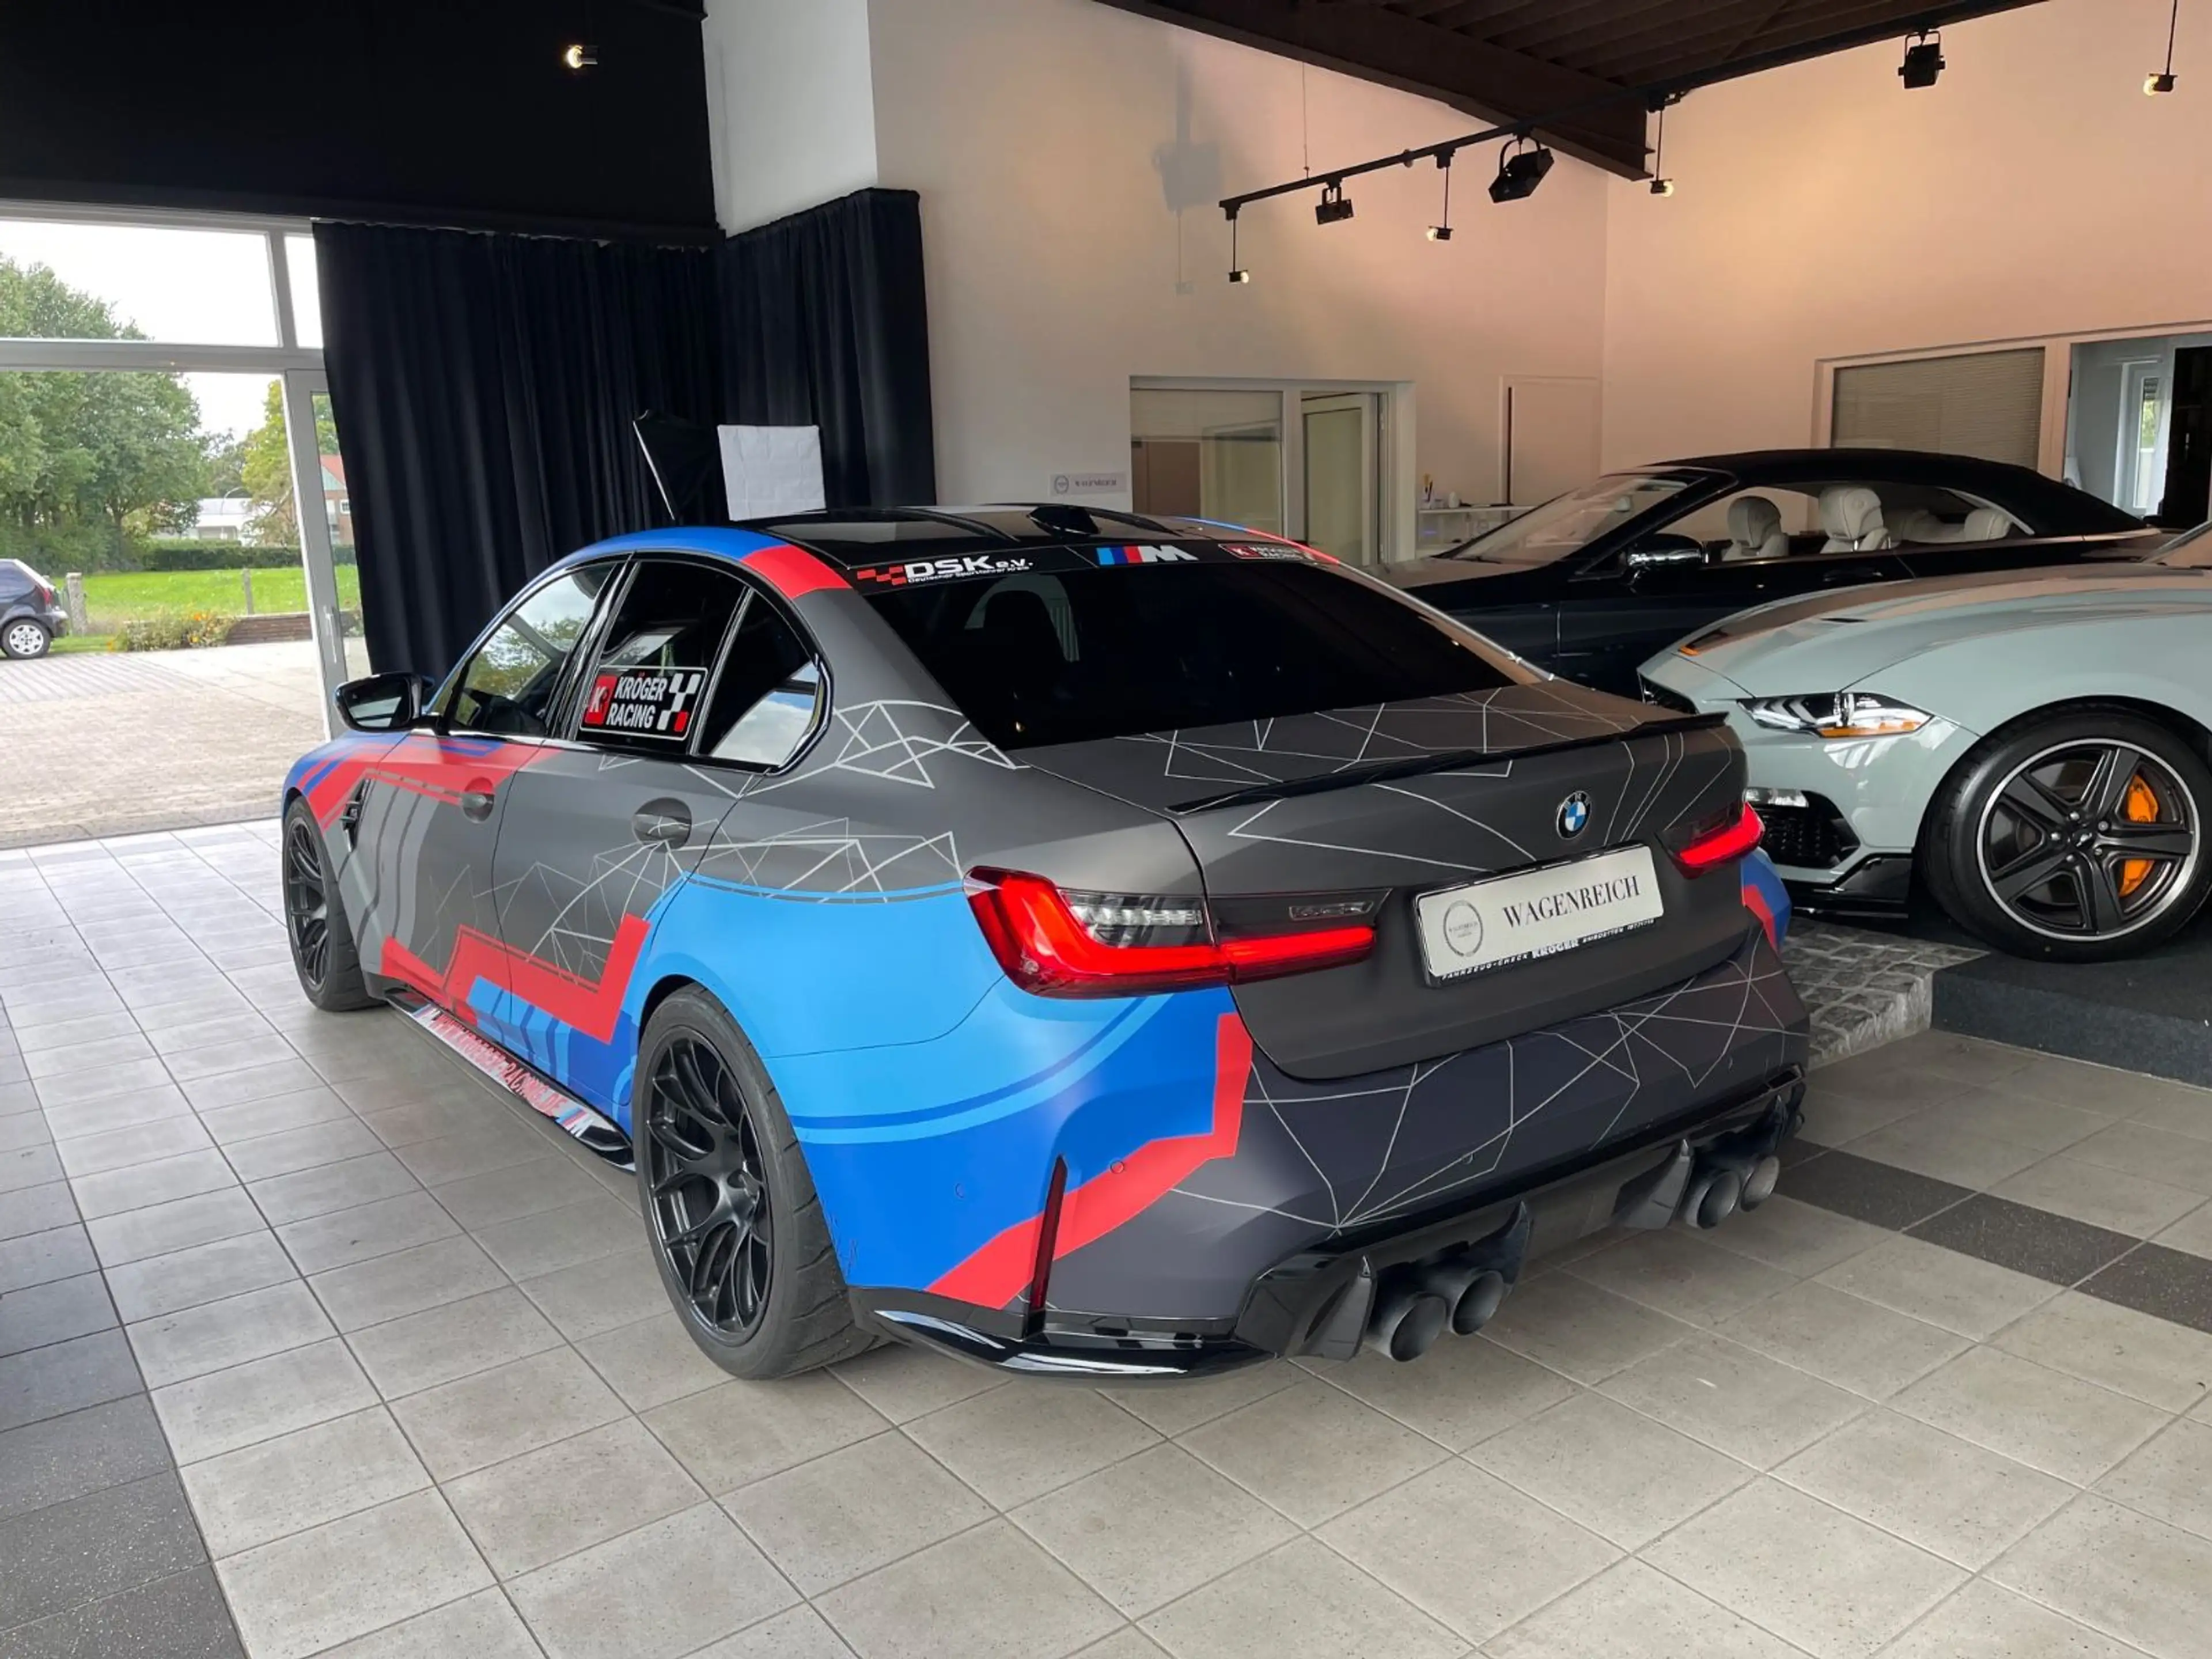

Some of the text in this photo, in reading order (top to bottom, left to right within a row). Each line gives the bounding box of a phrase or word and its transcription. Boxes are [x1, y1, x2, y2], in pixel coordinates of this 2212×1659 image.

[904, 555, 995, 578] DSK
[614, 672, 668, 701] KRÖGER
[605, 703, 656, 728] RACING
[1502, 875, 1641, 929] WAGENREICH
